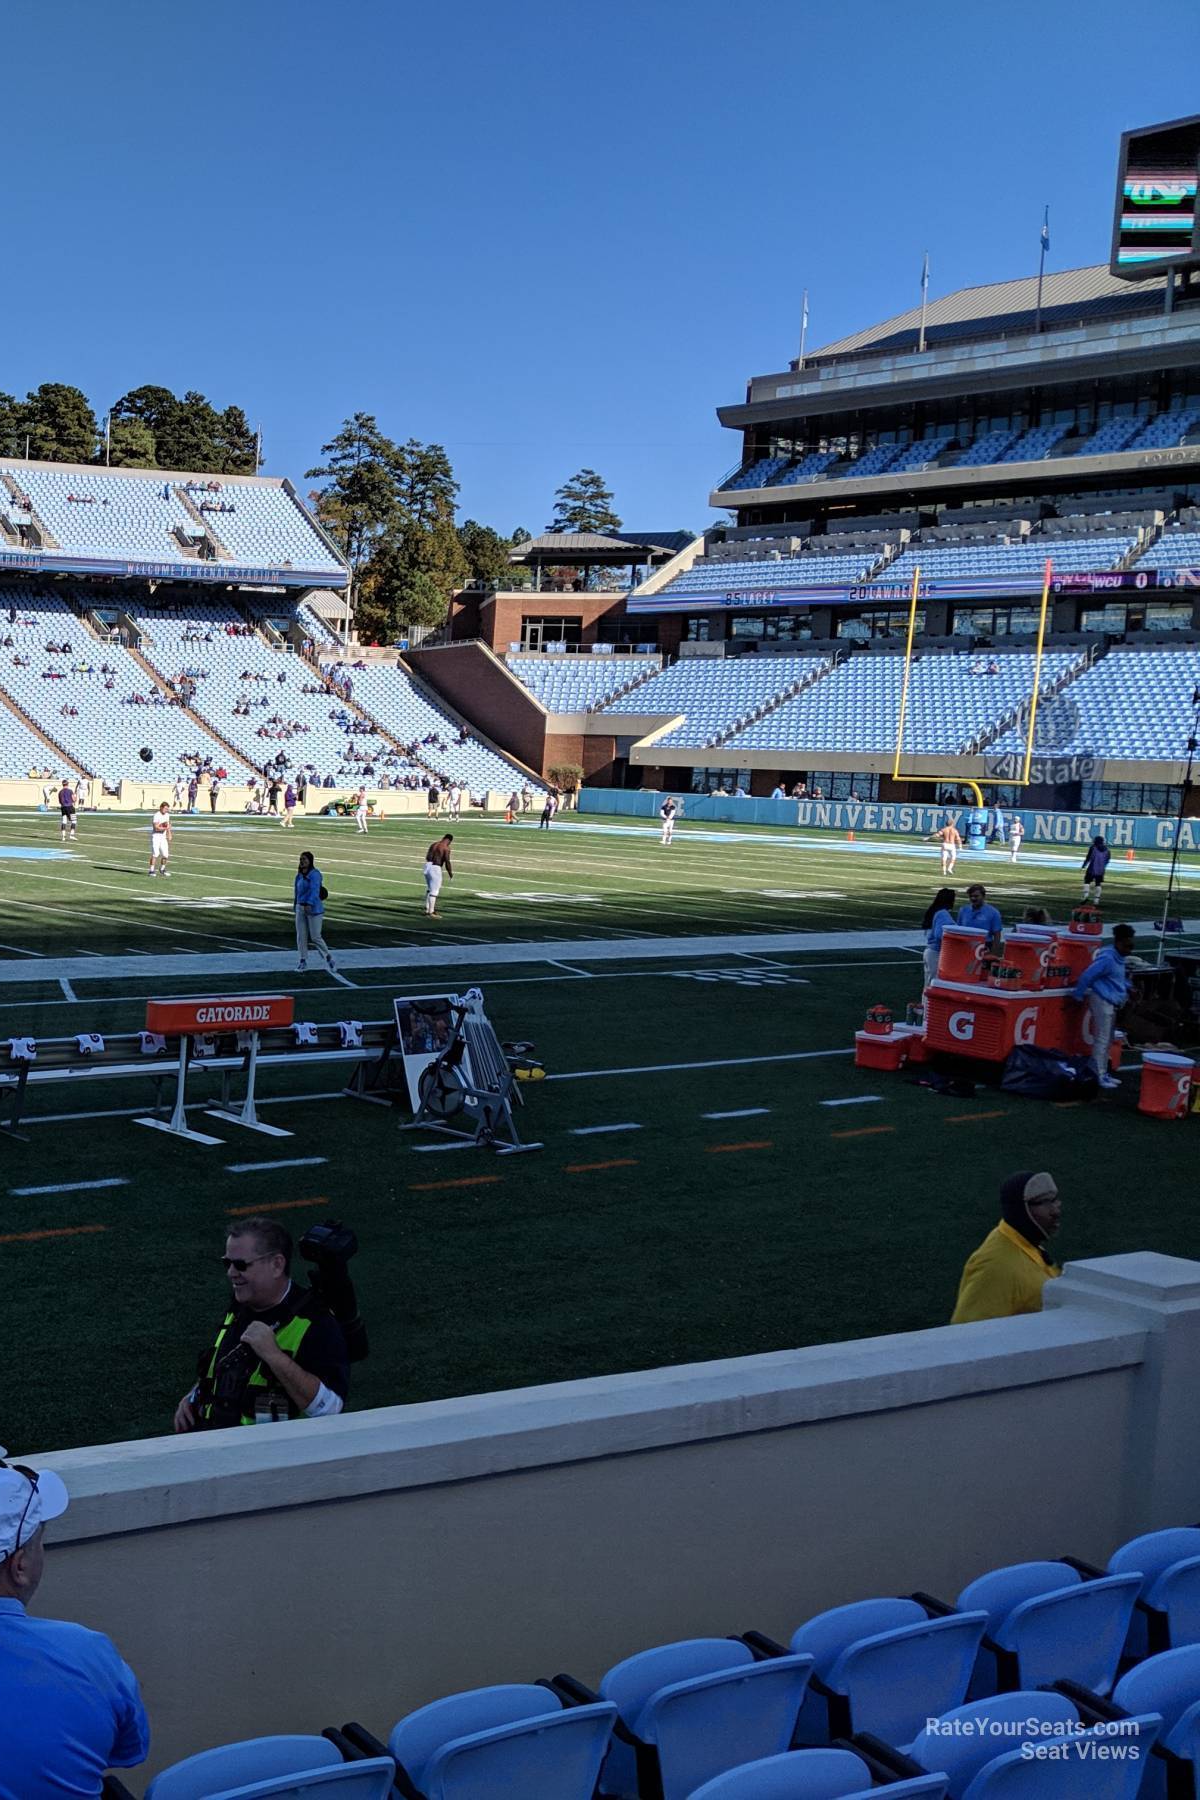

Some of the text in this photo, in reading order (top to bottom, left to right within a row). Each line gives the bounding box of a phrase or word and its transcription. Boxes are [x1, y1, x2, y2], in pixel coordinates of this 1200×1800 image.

[127, 562, 280, 582] WELCOME TO KENAN STADIUM
[1093, 575, 1123, 588] WCU
[1135, 572, 1148, 589] 0
[849, 586, 867, 600] 20
[996, 753, 1094, 785] Alstate
[798, 802, 963, 834] UNIVERSITY
[1033, 814, 1135, 846] NORTH
[196, 1005, 272, 1023] GATORADE
[949, 1011, 975, 1040] G
[1014, 1006, 1040, 1046] G
